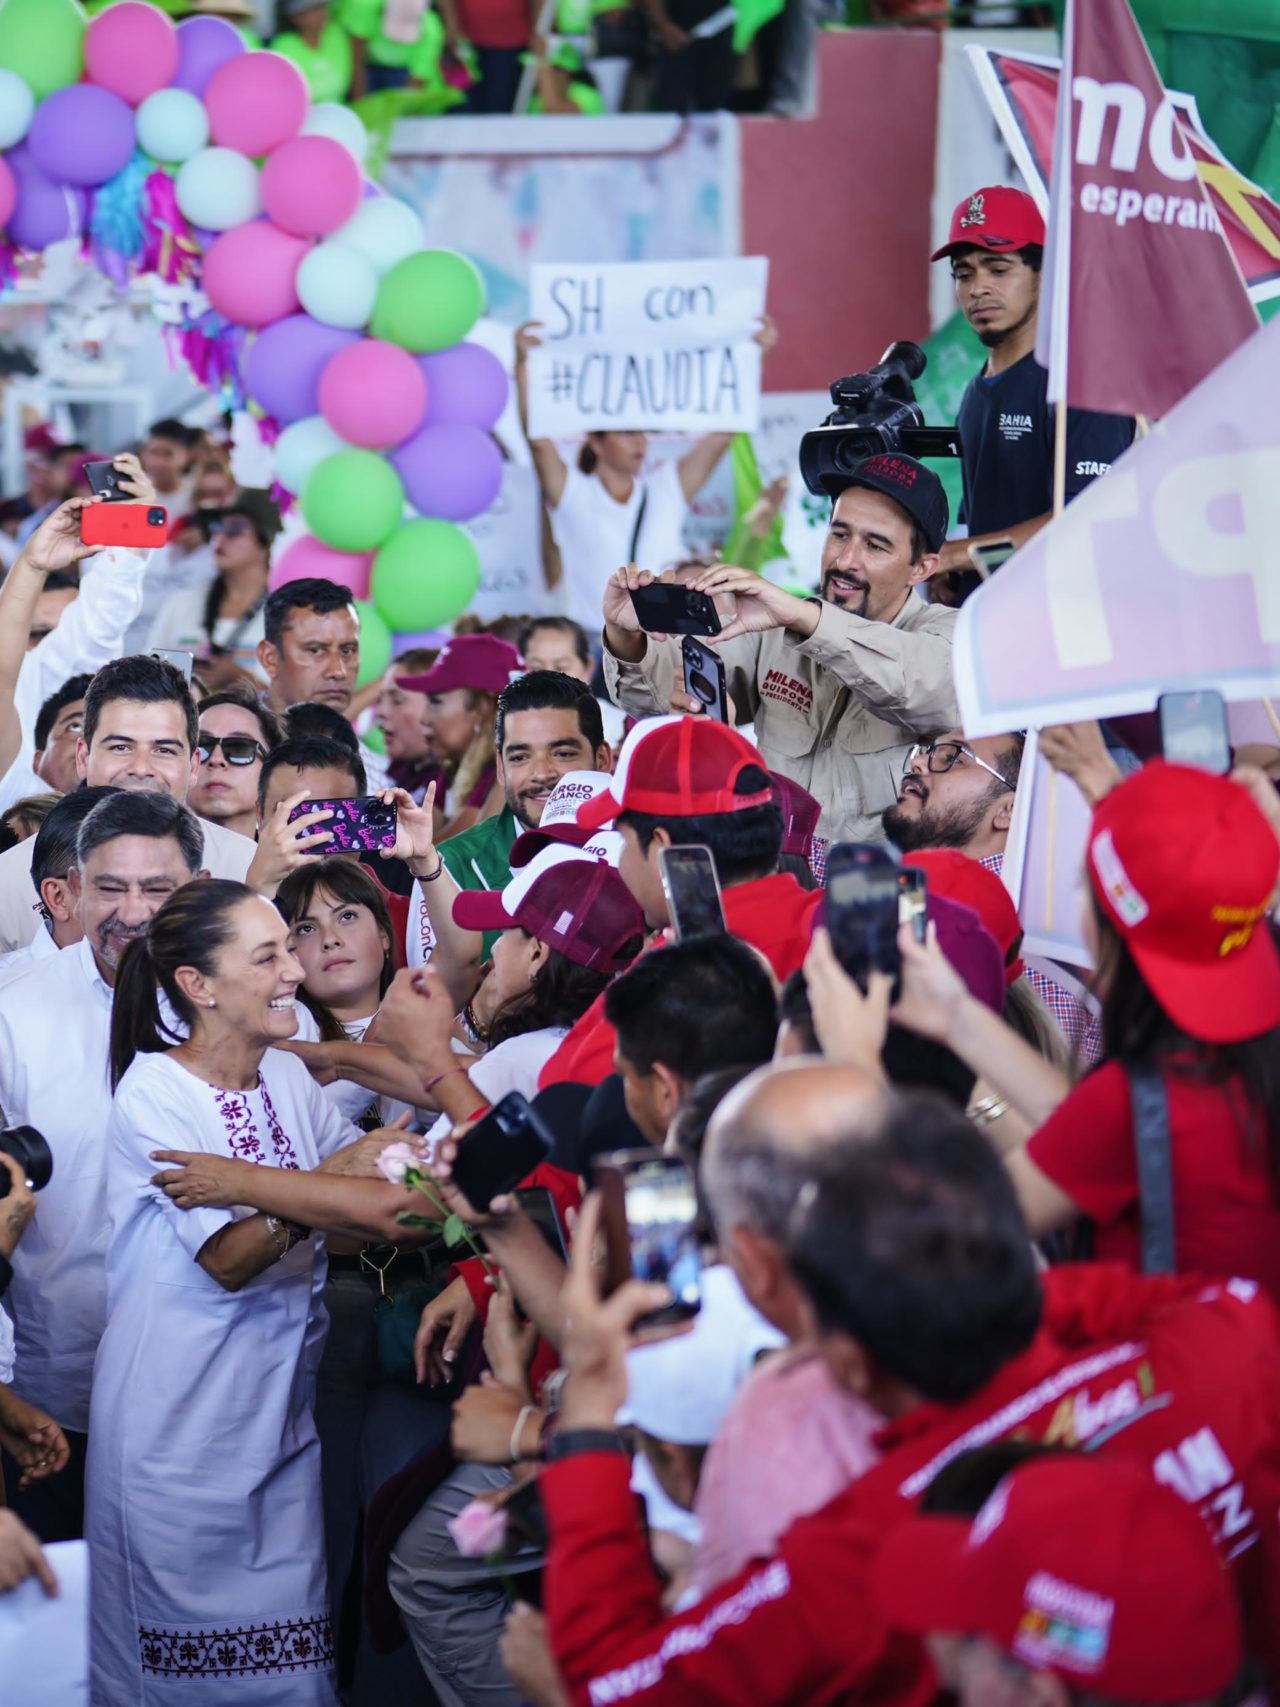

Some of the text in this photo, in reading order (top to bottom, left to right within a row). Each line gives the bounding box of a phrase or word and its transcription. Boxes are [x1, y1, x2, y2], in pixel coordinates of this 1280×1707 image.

[549, 275, 715, 340] SH con
[546, 346, 741, 416] #CLAUDIA
[998, 413, 1033, 428] BAHIA
[762, 682, 812, 709] QUIROGA
[765, 668, 814, 702] MILENA
[765, 691, 803, 711] PRESIDENTA
